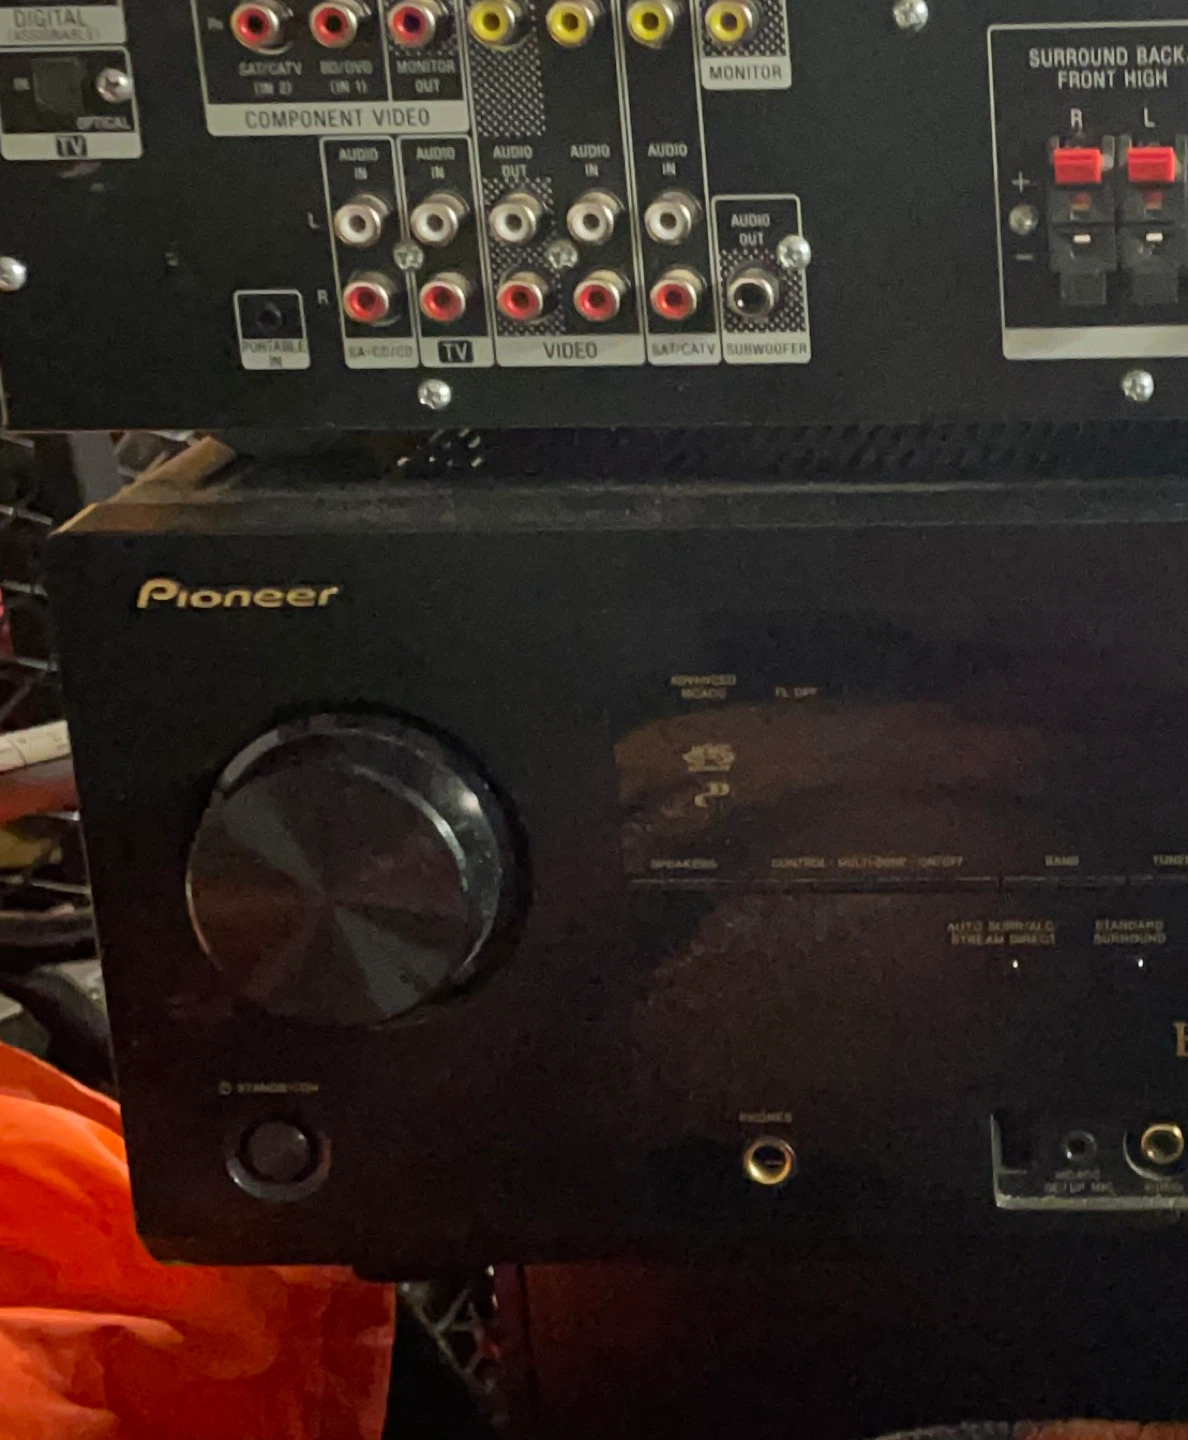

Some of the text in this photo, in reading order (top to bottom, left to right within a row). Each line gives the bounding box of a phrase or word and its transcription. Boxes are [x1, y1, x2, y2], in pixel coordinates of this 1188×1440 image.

[13, 8, 88, 29] DIGITAL
[1028, 47, 1129, 69] SURROUND
[396, 59, 455, 75] MONITOR
[708, 64, 783, 82] MONITOR
[415, 78, 440, 94] OUT
[1058, 68, 1169, 90] FRONT HIGH
[245, 107, 431, 130] COMPONENT VIDEO
[1070, 108, 1083, 128] R
[1143, 107, 1156, 128] L
[56, 136, 87, 157] TV
[416, 147, 456, 161] AUDIO
[493, 145, 533, 159] AUDIO
[570, 144, 610, 159] AUDIO
[648, 143, 688, 158] AUDIO
[339, 147, 379, 162] AUDIO
[354, 166, 368, 179] IN
[431, 165, 445, 179] IN
[502, 164, 527, 178] OUT
[585, 163, 599, 177] IN
[662, 162, 676, 176] IN
[307, 212, 319, 230] L
[730, 213, 771, 228] AUDIO
[739, 232, 764, 247] OUT
[317, 290, 330, 306] R
[440, 343, 471, 362] TV
[542, 341, 598, 360] VIDEO
[726, 341, 807, 356] SUBWOOFER
[136, 576, 340, 610] Pioneer
[1094, 919, 1165, 933] STANDARD
[1092, 931, 1167, 946] SURROUND
